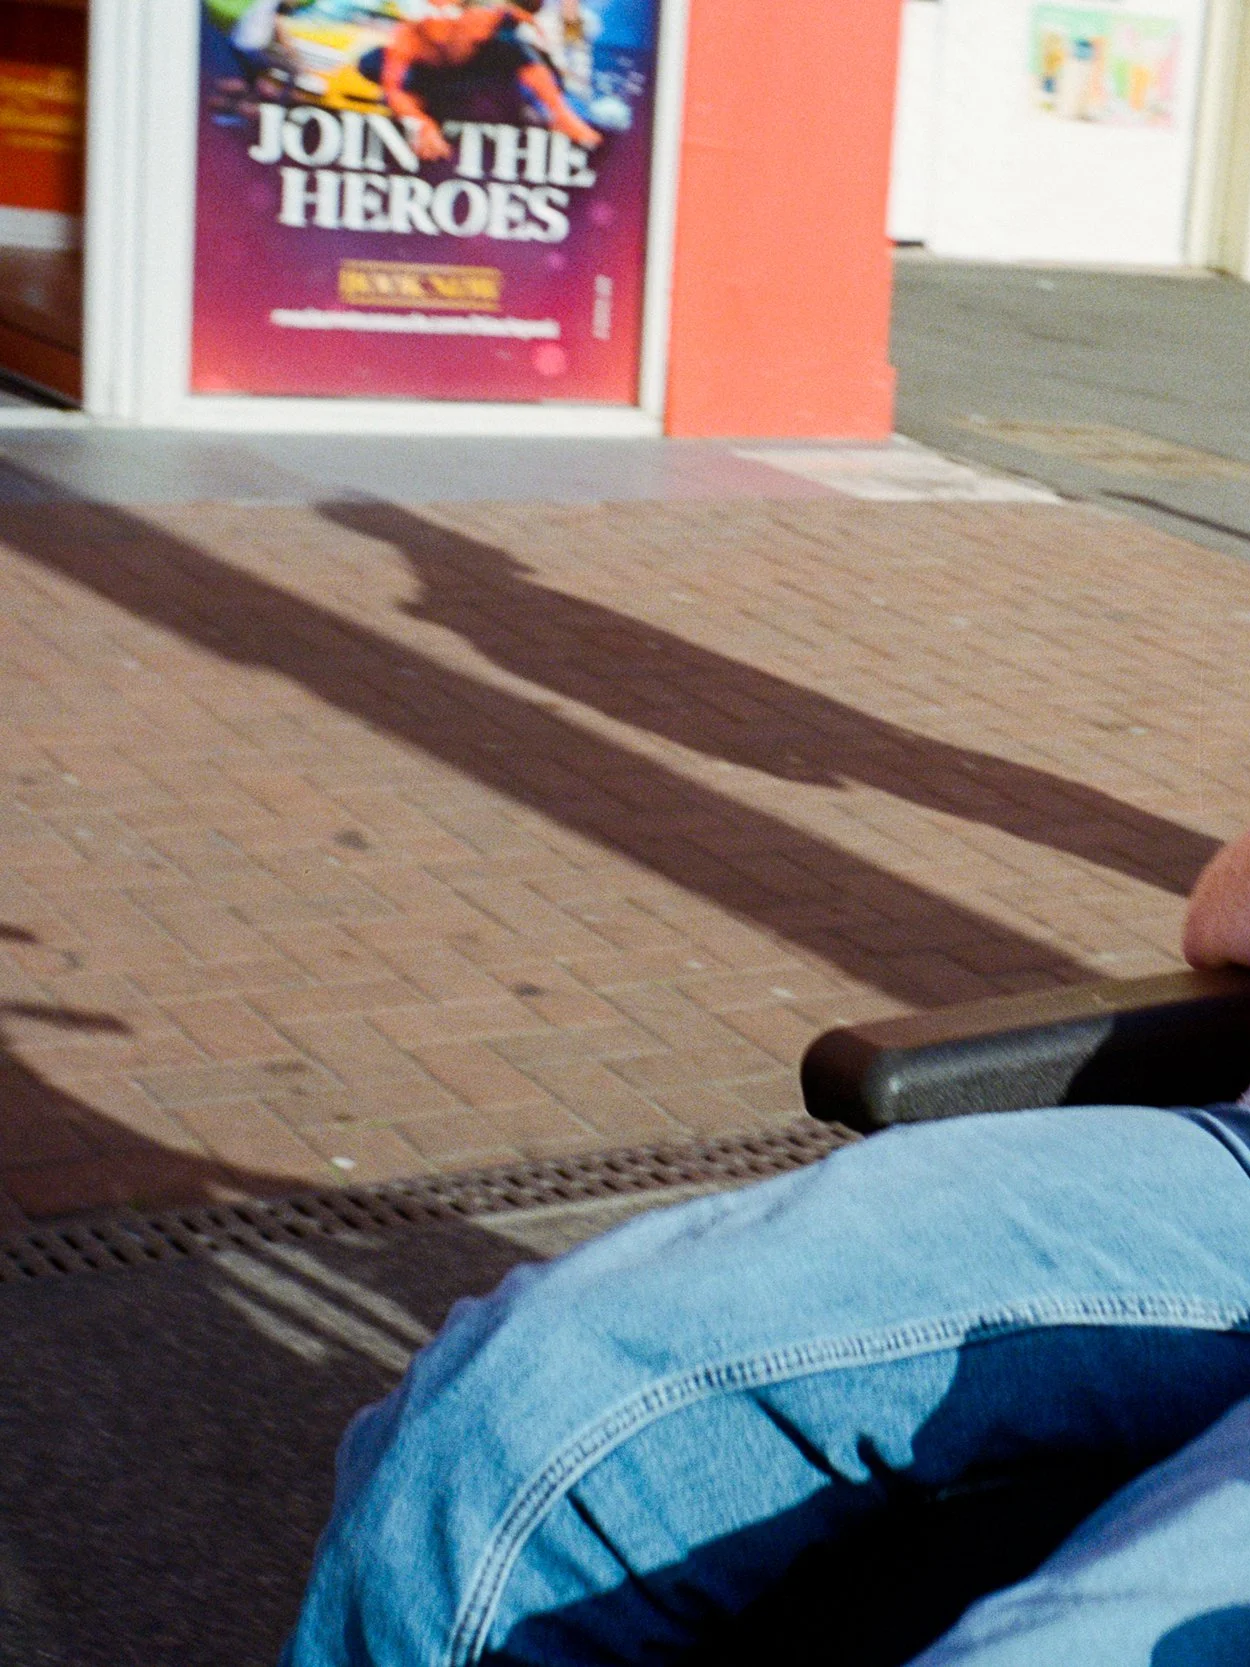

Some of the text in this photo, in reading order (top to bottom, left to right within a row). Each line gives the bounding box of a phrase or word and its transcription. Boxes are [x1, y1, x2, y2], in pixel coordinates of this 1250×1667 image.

[249, 103, 597, 188] JOIN THE
[278, 166, 569, 243] HEROES
